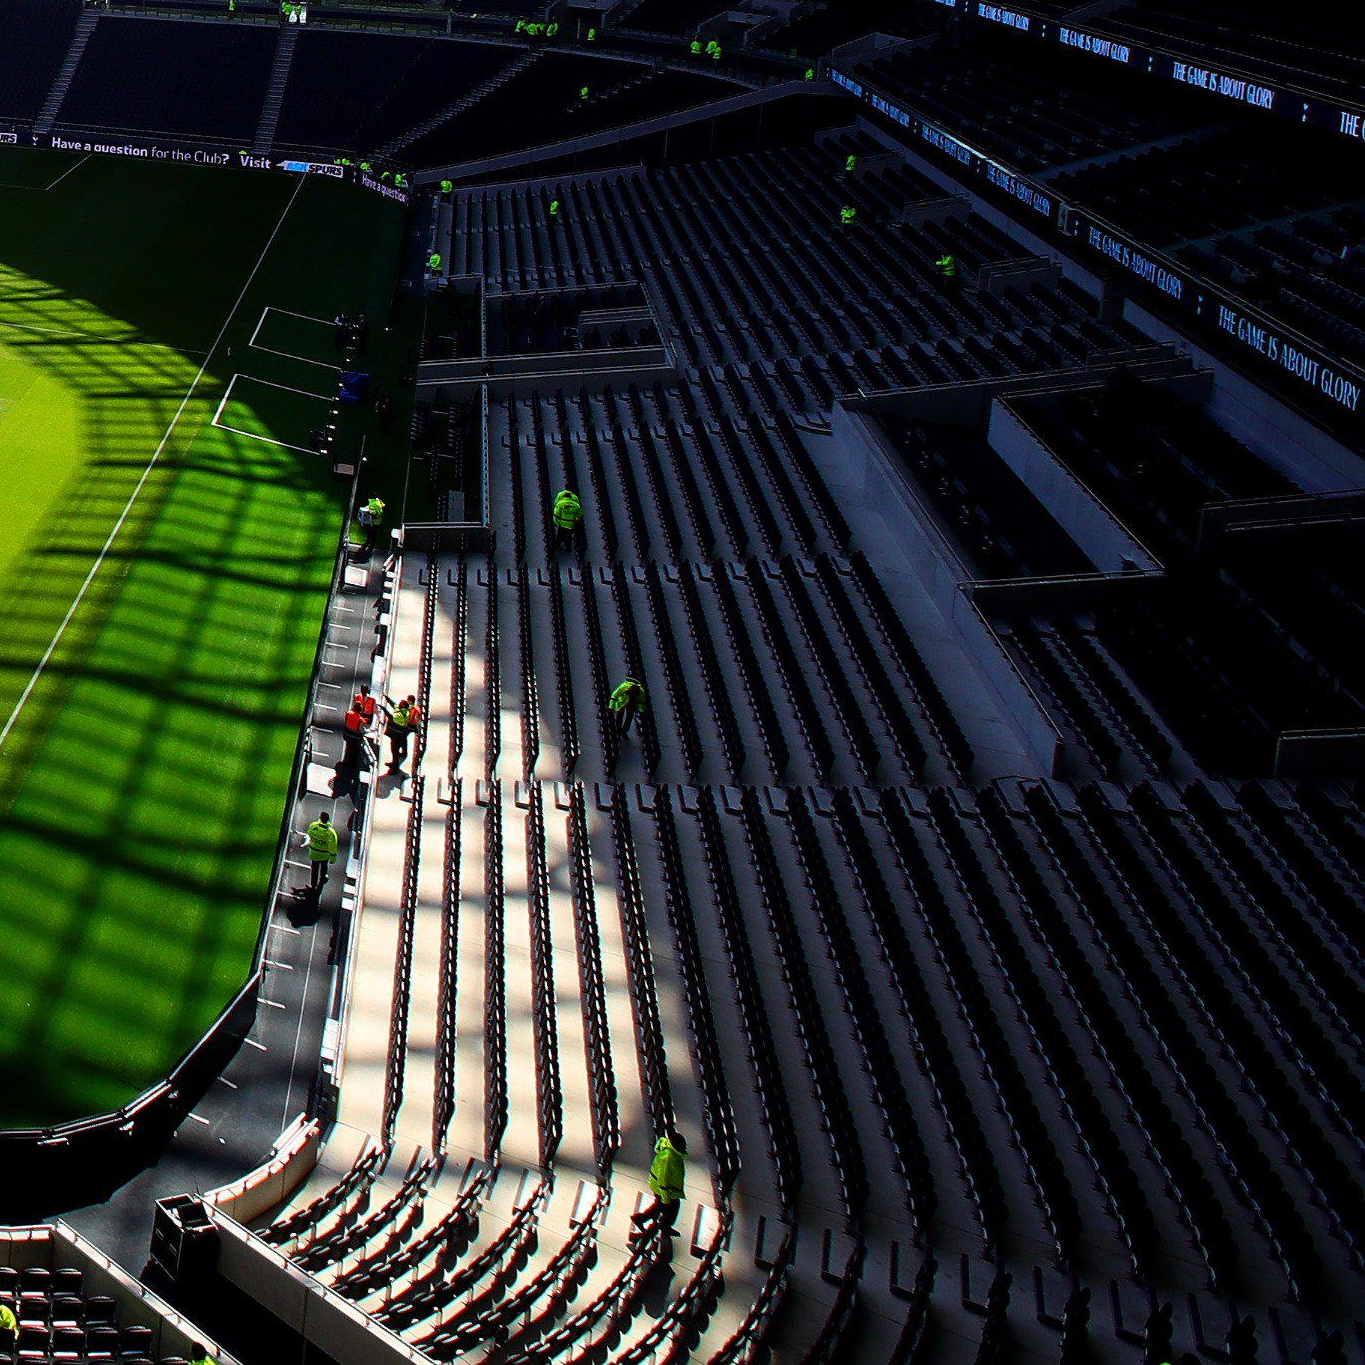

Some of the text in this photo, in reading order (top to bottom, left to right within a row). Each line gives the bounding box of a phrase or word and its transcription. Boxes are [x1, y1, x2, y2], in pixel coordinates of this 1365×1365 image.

[1173, 61, 1275, 109] THE GAME IS ABOUT GLORY
[1340, 112, 1360, 137] THE
[52, 137, 271, 169] Have a question for the Club? Visit
[1089, 226, 1182, 300] THE GAME IS ABOUT GLORY
[1219, 305, 1361, 411] THE GAME IS ABOUT GLORY
